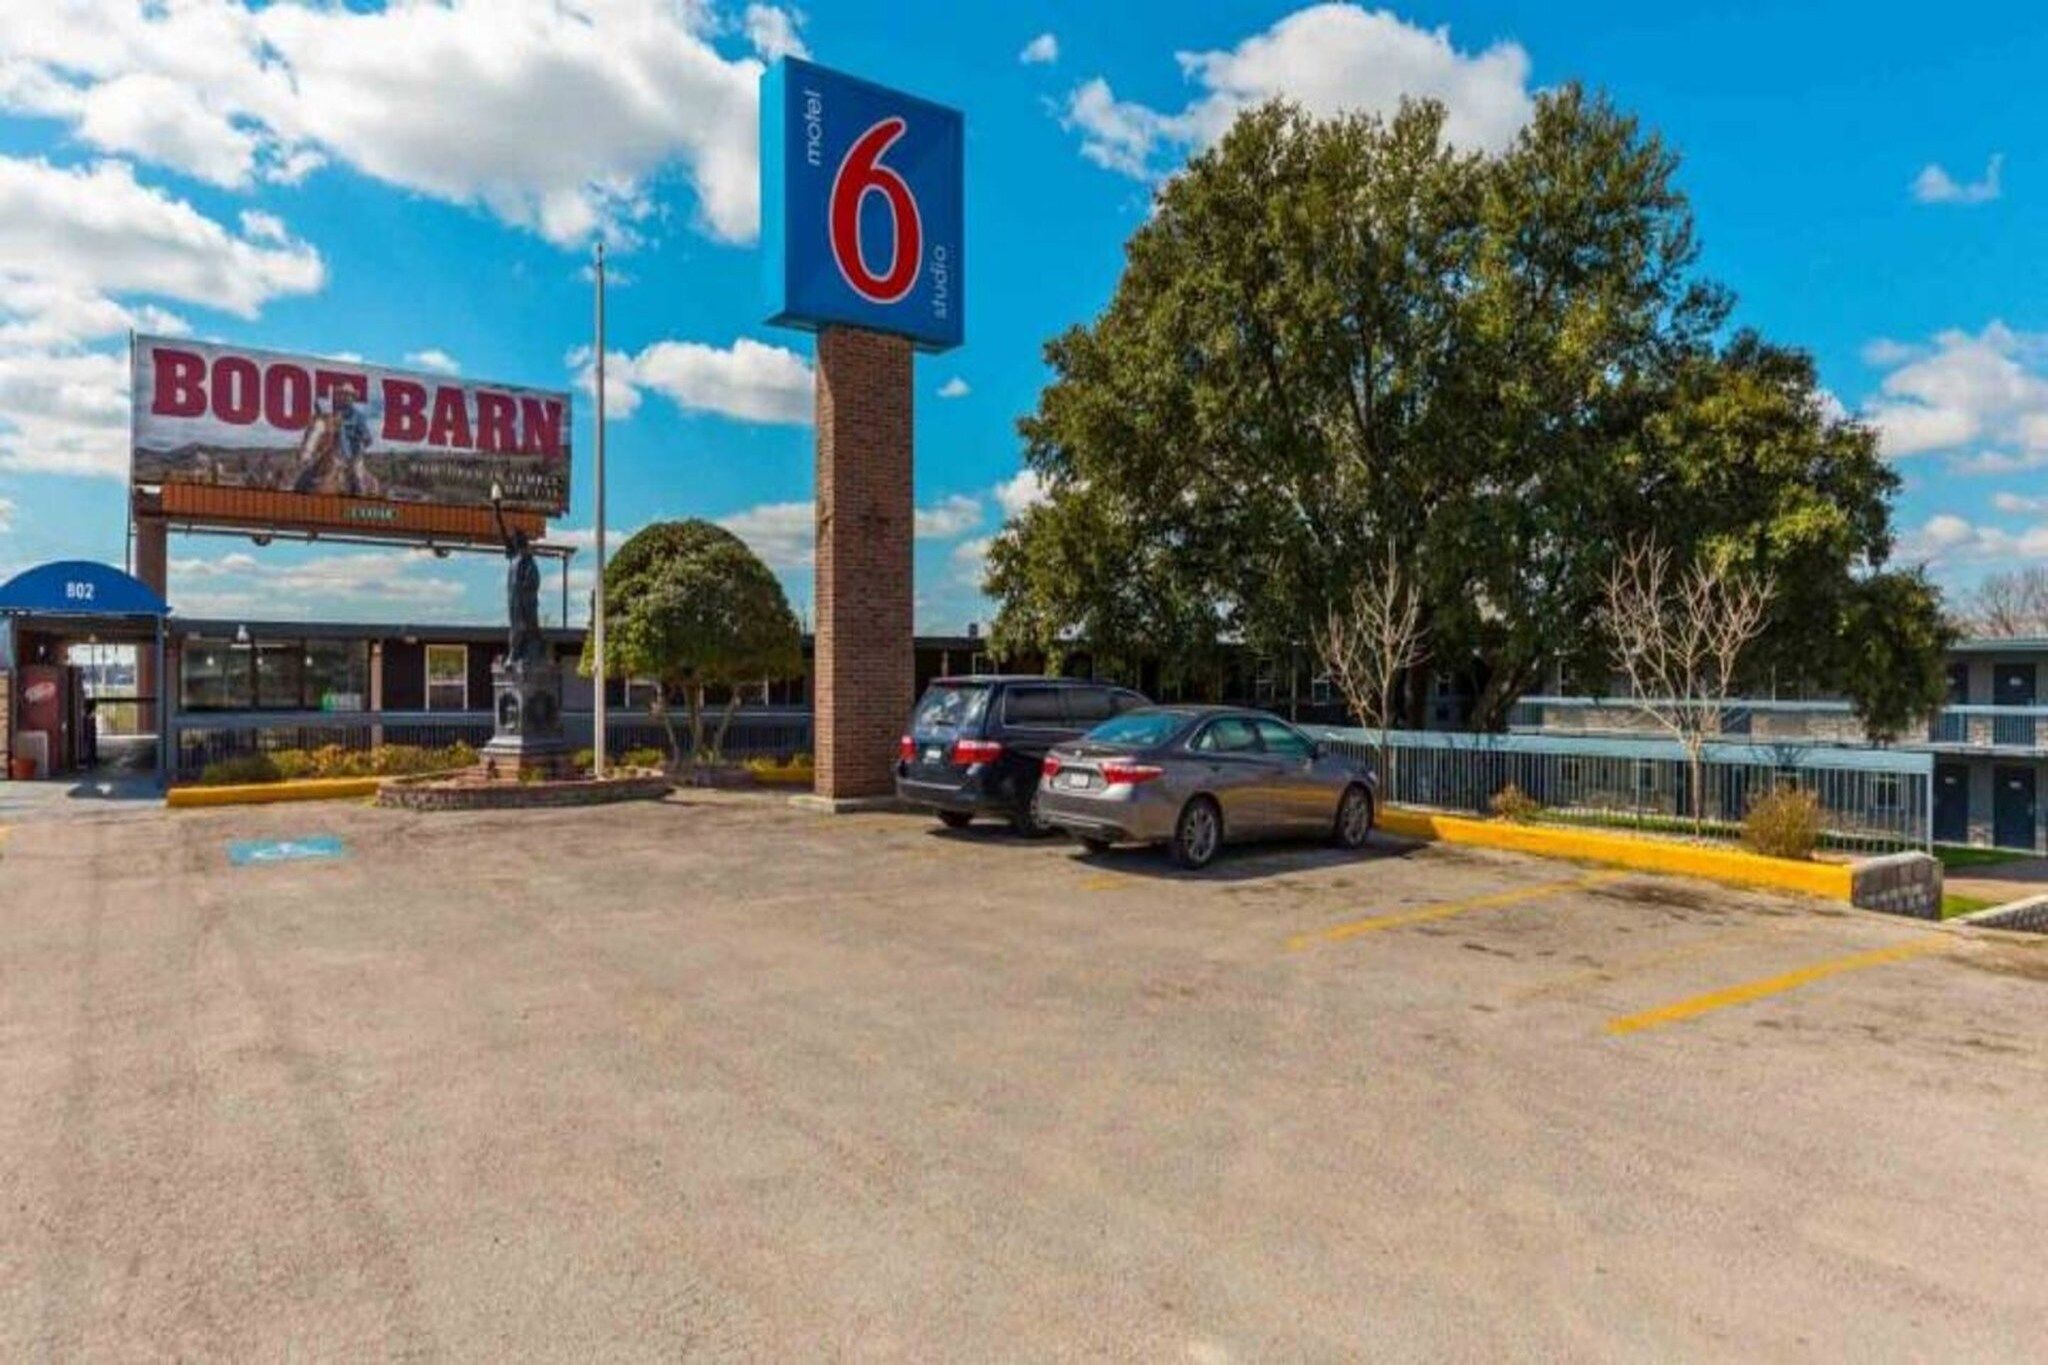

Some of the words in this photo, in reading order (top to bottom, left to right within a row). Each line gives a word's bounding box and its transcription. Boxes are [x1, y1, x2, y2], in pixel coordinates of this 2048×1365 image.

[804, 89, 822, 166] motel
[829, 116, 922, 304] 6
[930, 245, 947, 320] studio
[152, 348, 367, 431] BOOT
[381, 379, 562, 460] BARN
[66, 582, 94, 600] 802
